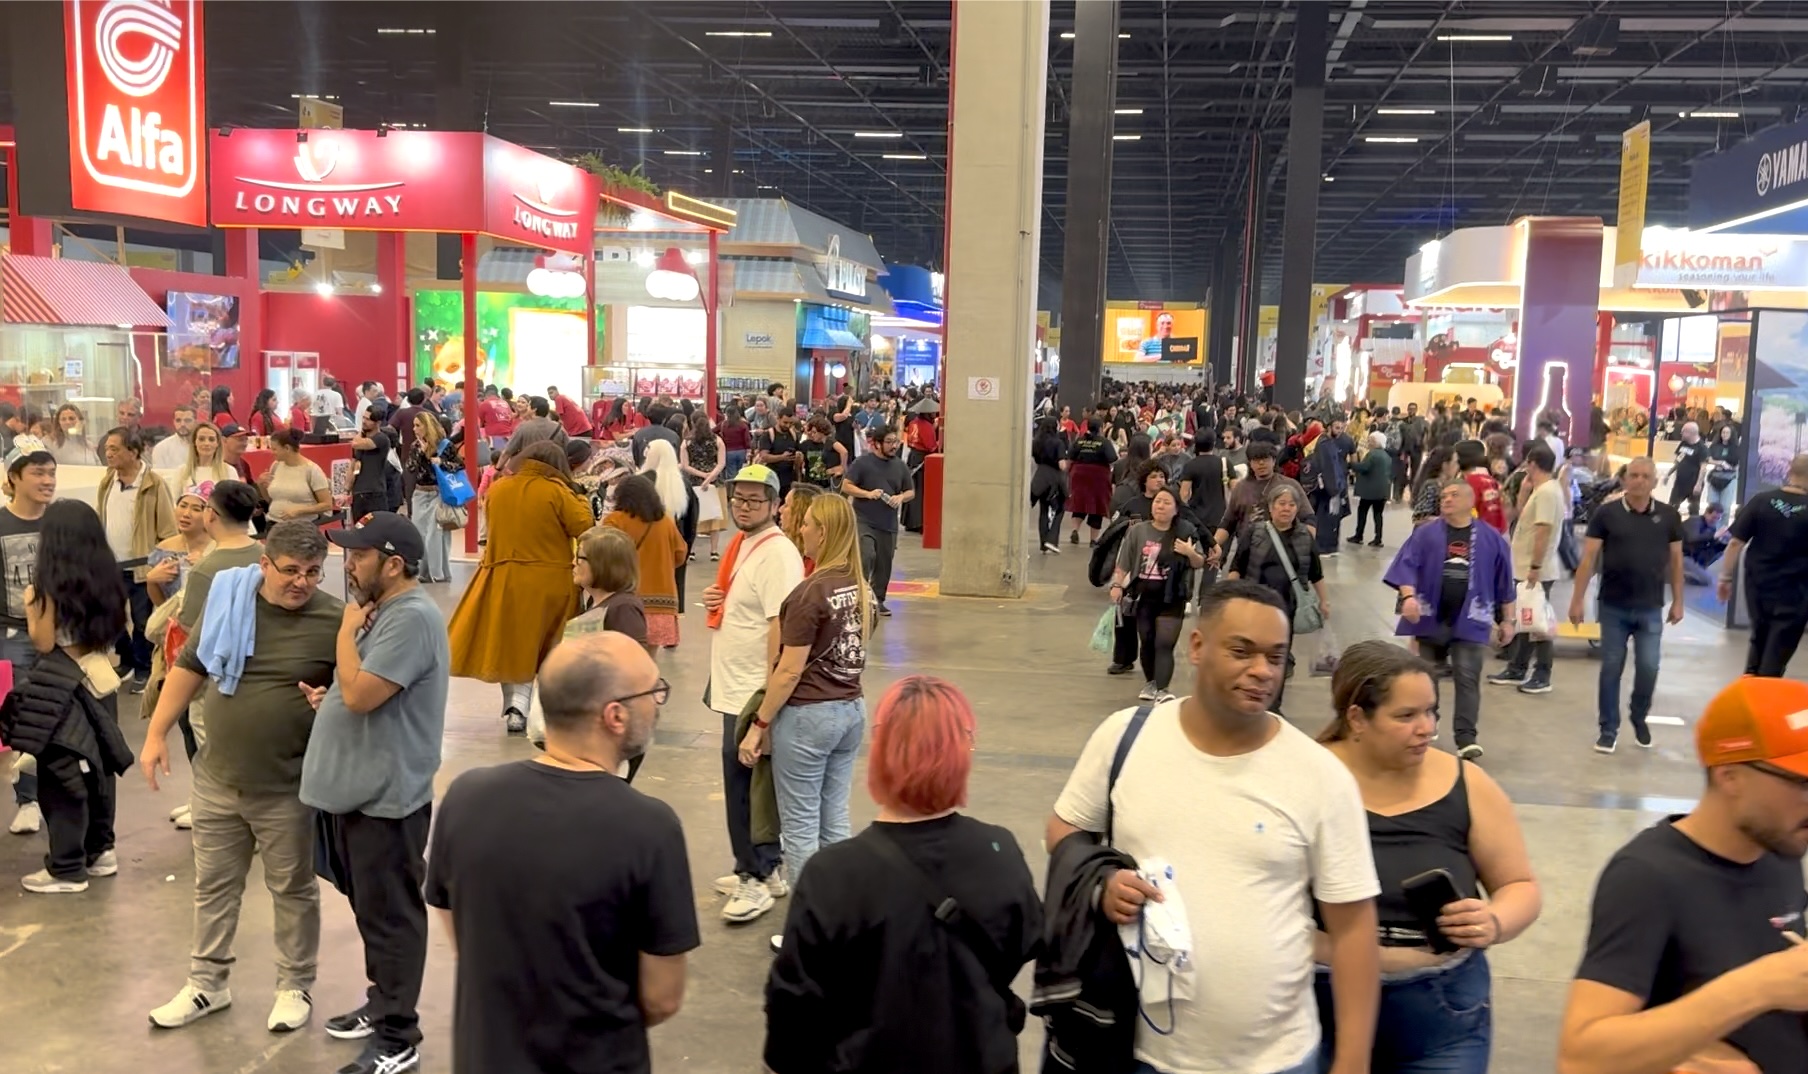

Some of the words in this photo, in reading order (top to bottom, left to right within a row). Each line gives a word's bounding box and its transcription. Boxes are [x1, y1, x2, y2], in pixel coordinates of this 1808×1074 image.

[96, 103, 184, 176] Alfa
[1772, 140, 1808, 190] YAMA
[235, 191, 402, 217] LONGWAY
[512, 205, 579, 239] LONGWAY
[1640, 249, 1763, 271] kikkoman
